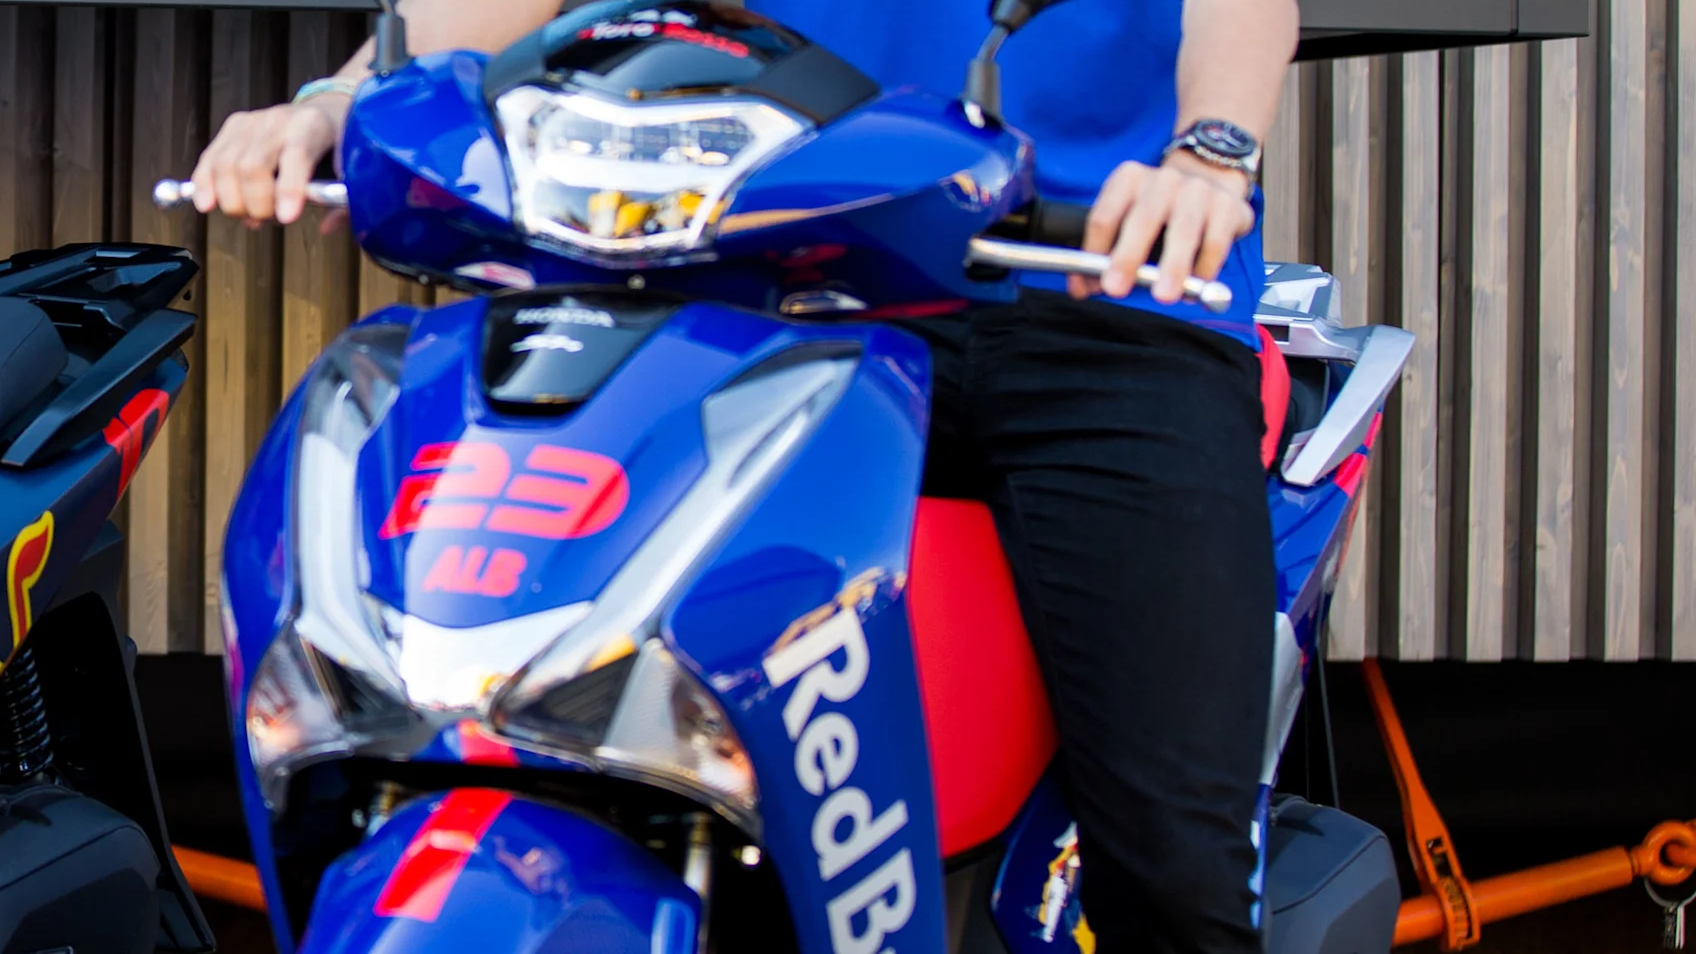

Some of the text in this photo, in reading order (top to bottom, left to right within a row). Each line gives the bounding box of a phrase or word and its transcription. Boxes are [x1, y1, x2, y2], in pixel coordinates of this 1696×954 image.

[512, 306, 616, 328] HONDA
[378, 441, 631, 540] 23
[421, 545, 528, 598] ALB
